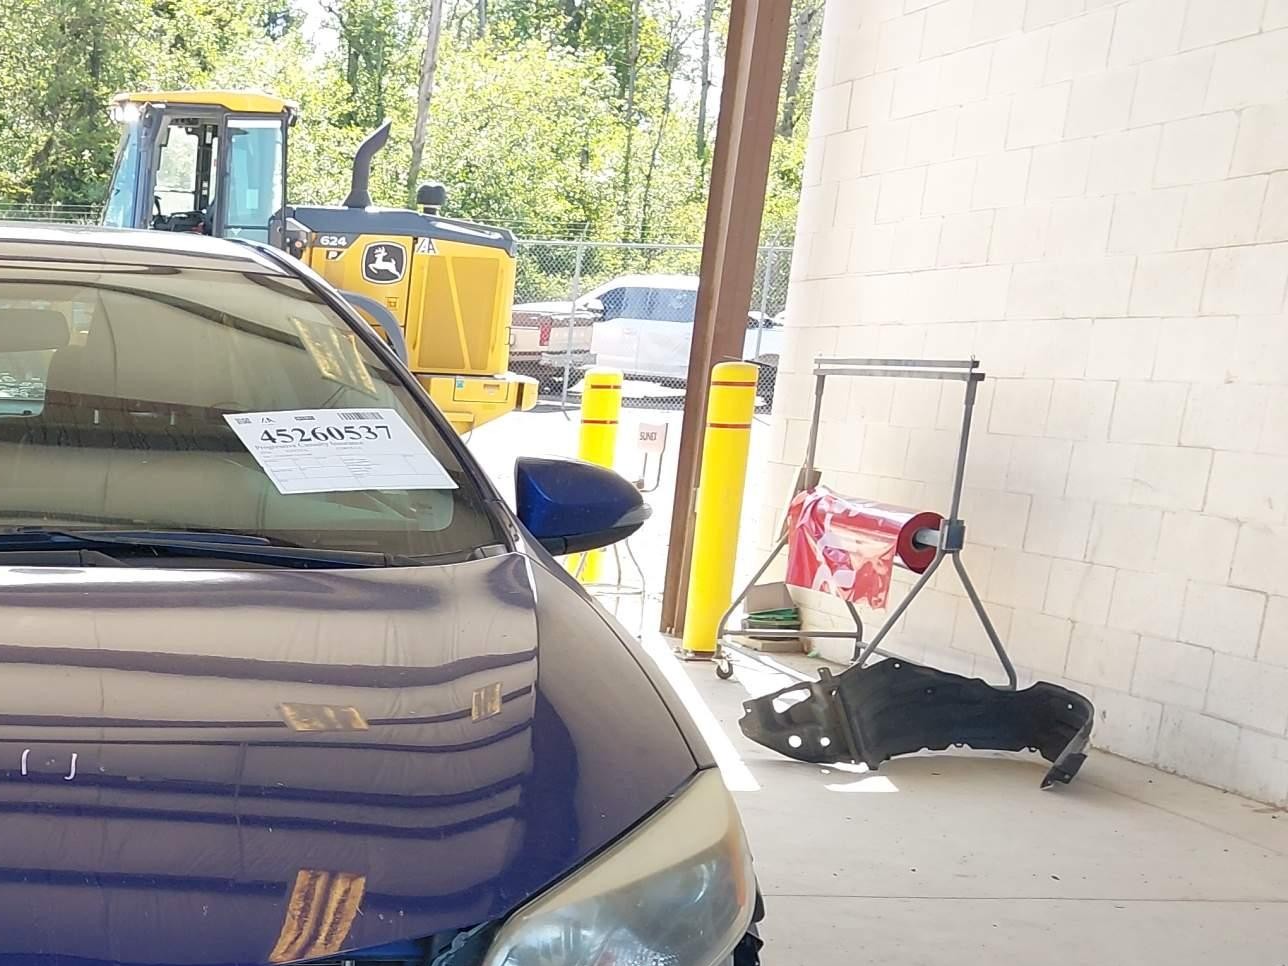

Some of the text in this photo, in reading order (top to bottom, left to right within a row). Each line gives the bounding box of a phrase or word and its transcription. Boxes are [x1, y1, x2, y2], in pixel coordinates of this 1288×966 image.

[319, 235, 348, 246] 624
[327, 250, 338, 260] P
[260, 425, 392, 444] 45260537
